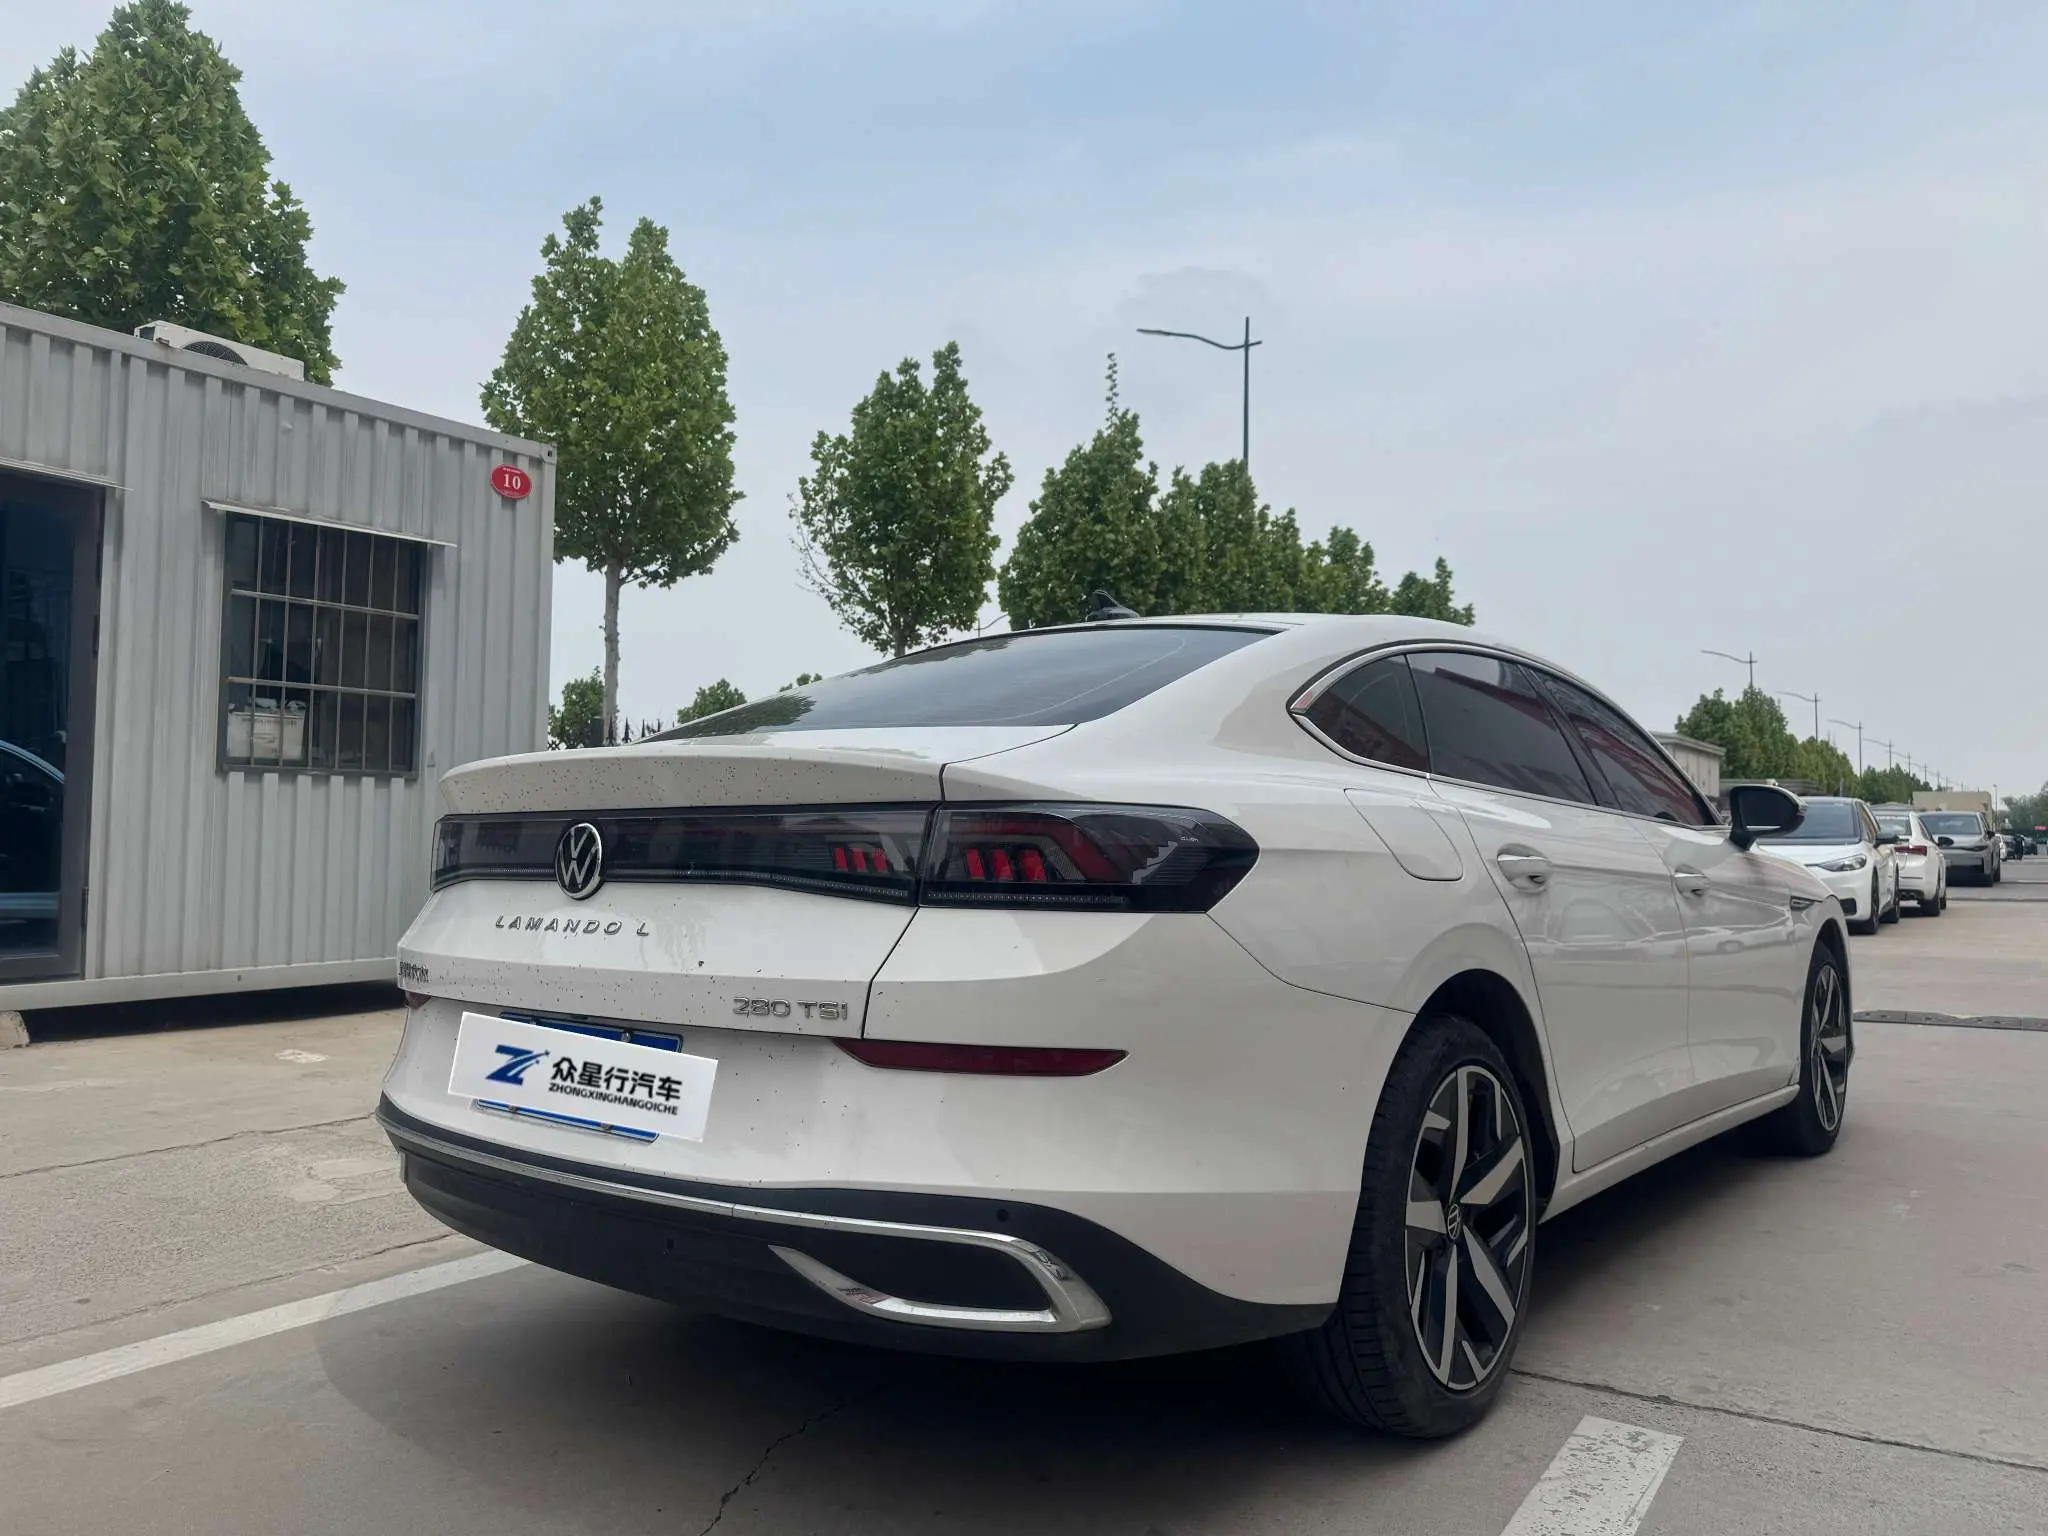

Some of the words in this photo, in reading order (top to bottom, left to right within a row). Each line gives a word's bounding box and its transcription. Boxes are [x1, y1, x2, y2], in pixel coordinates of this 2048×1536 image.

[503, 473, 521, 490] 10
[495, 915, 623, 936] LAMANDO
[636, 922, 650, 937] L
[732, 997, 791, 1018] 280
[797, 1001, 848, 1021] TSI
